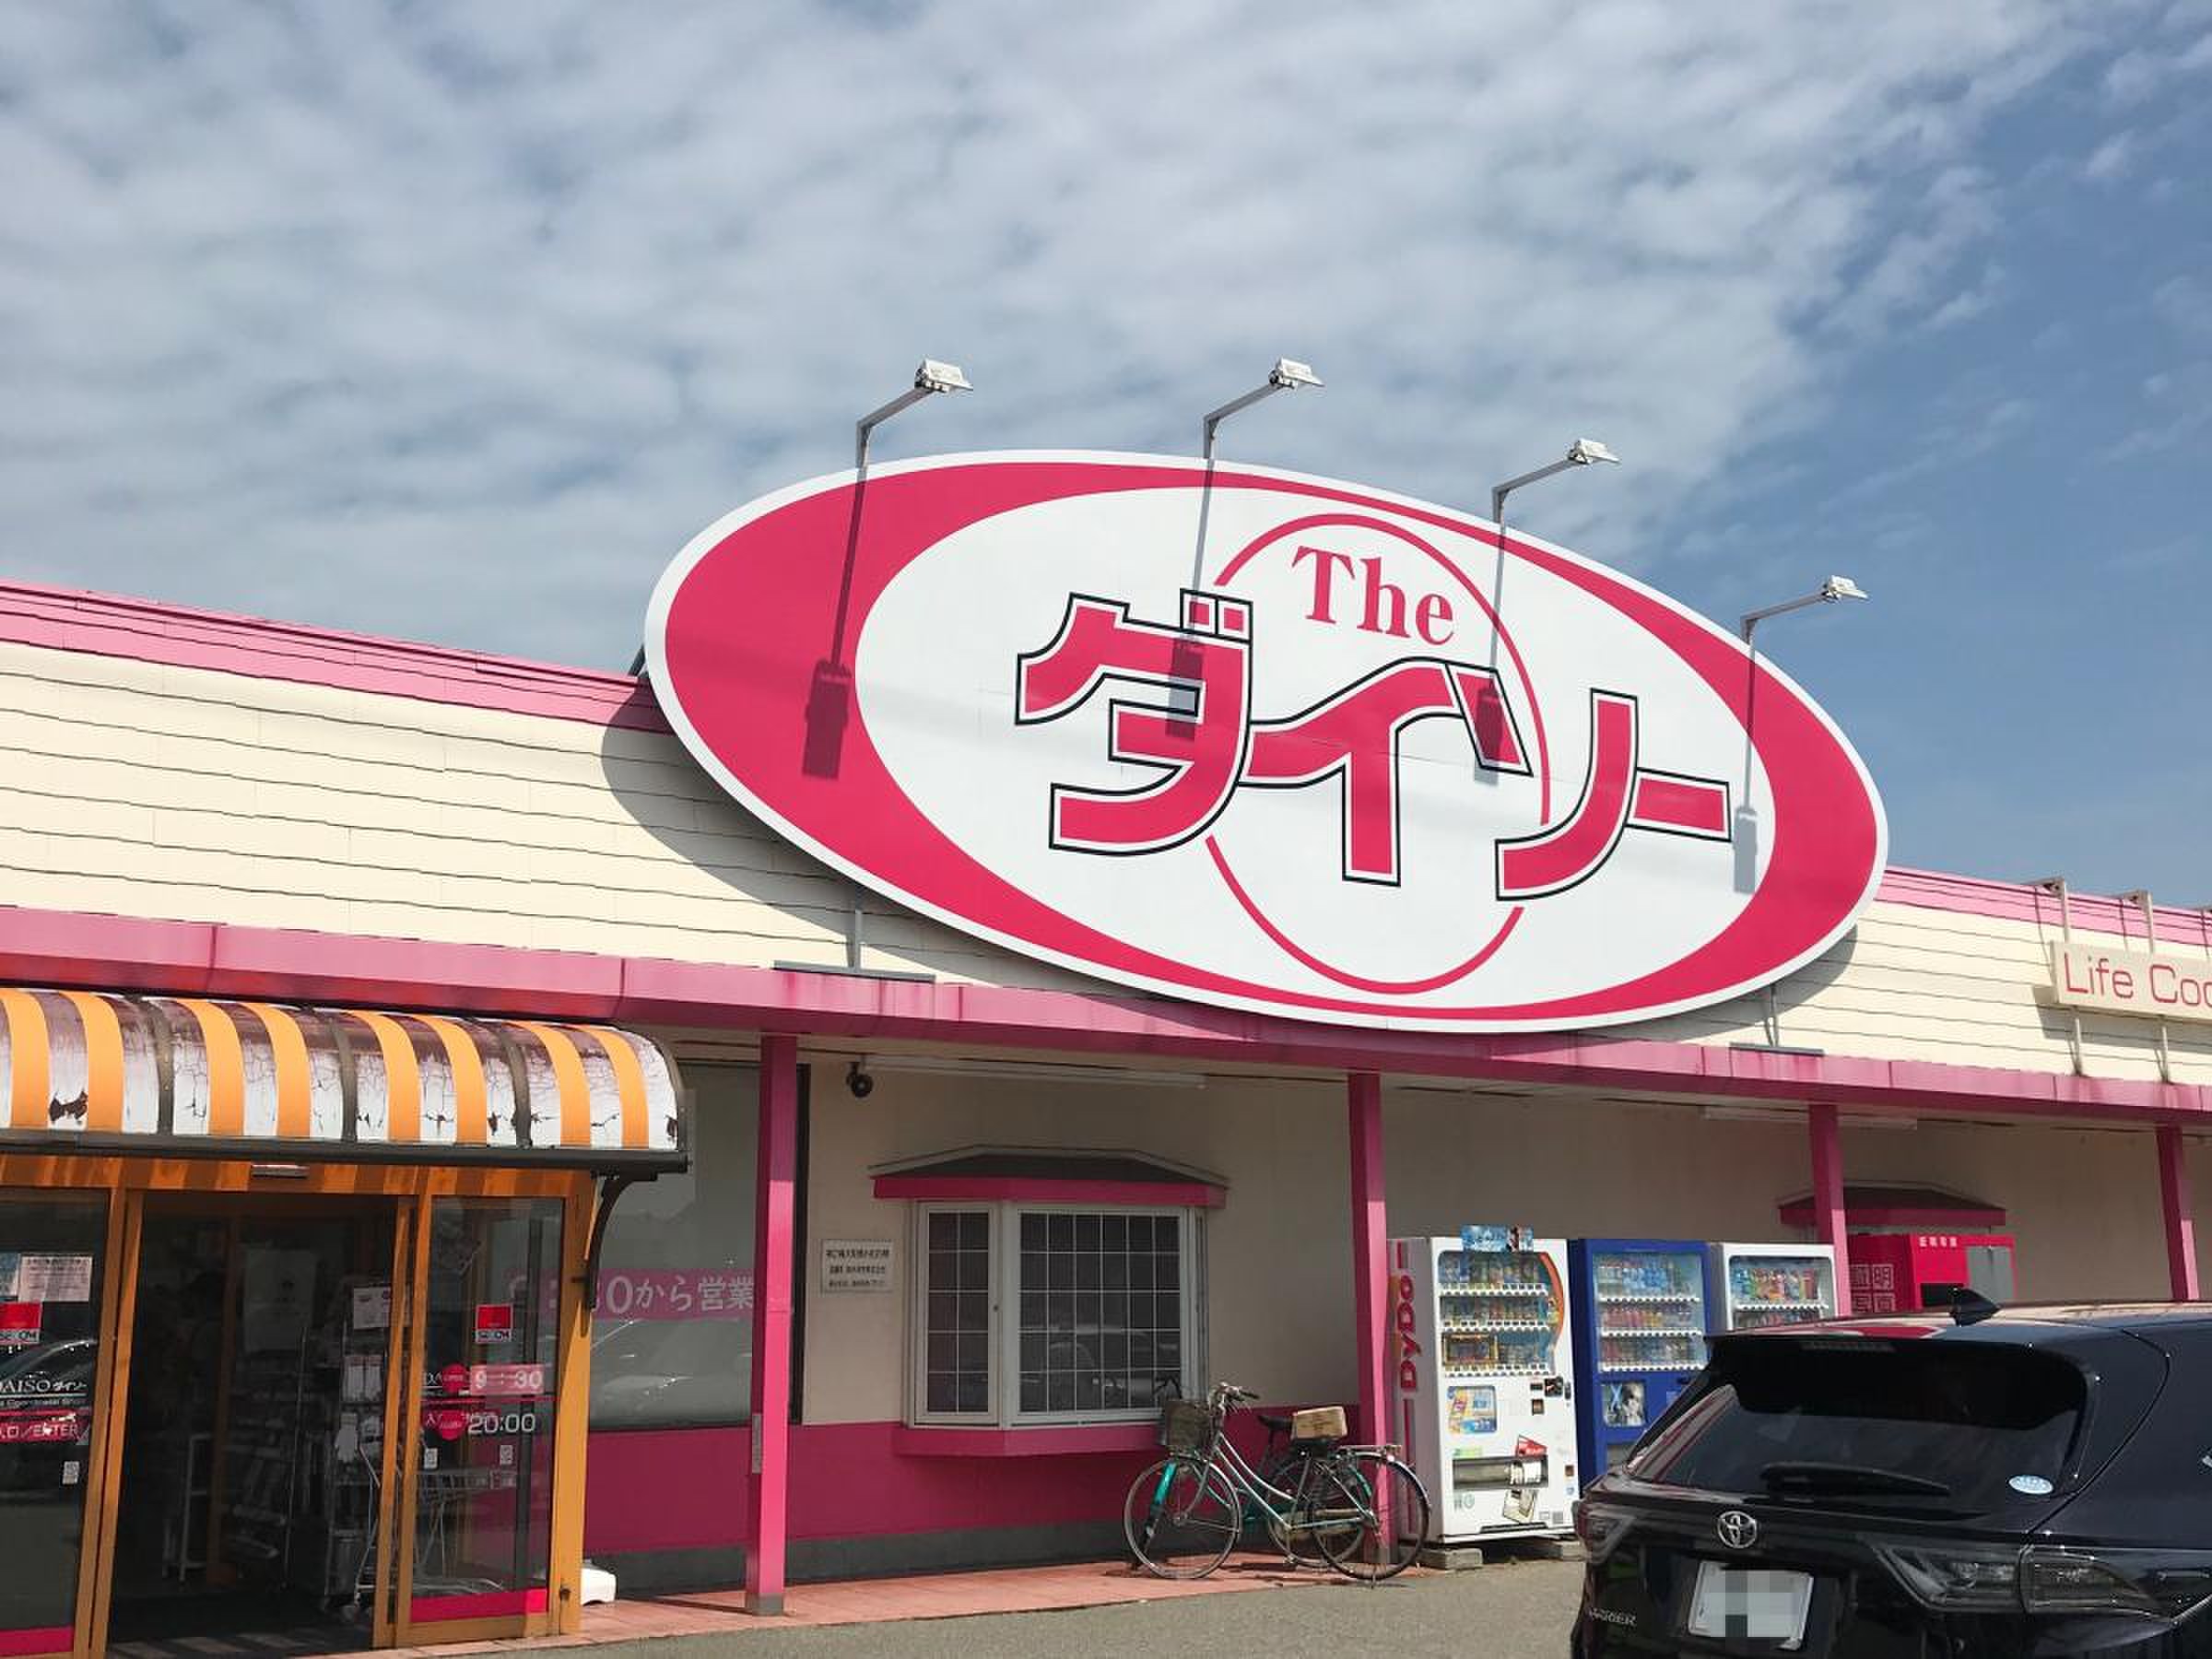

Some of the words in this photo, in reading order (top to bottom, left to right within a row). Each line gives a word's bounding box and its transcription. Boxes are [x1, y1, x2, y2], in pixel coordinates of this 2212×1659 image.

[1291, 545, 1454, 645] The
[1015, 588, 1733, 901] ダイソー
[2064, 952, 2135, 999] Life
[0, 1380, 51, 1393] AISO
[468, 1413, 535, 1435] 20:00
